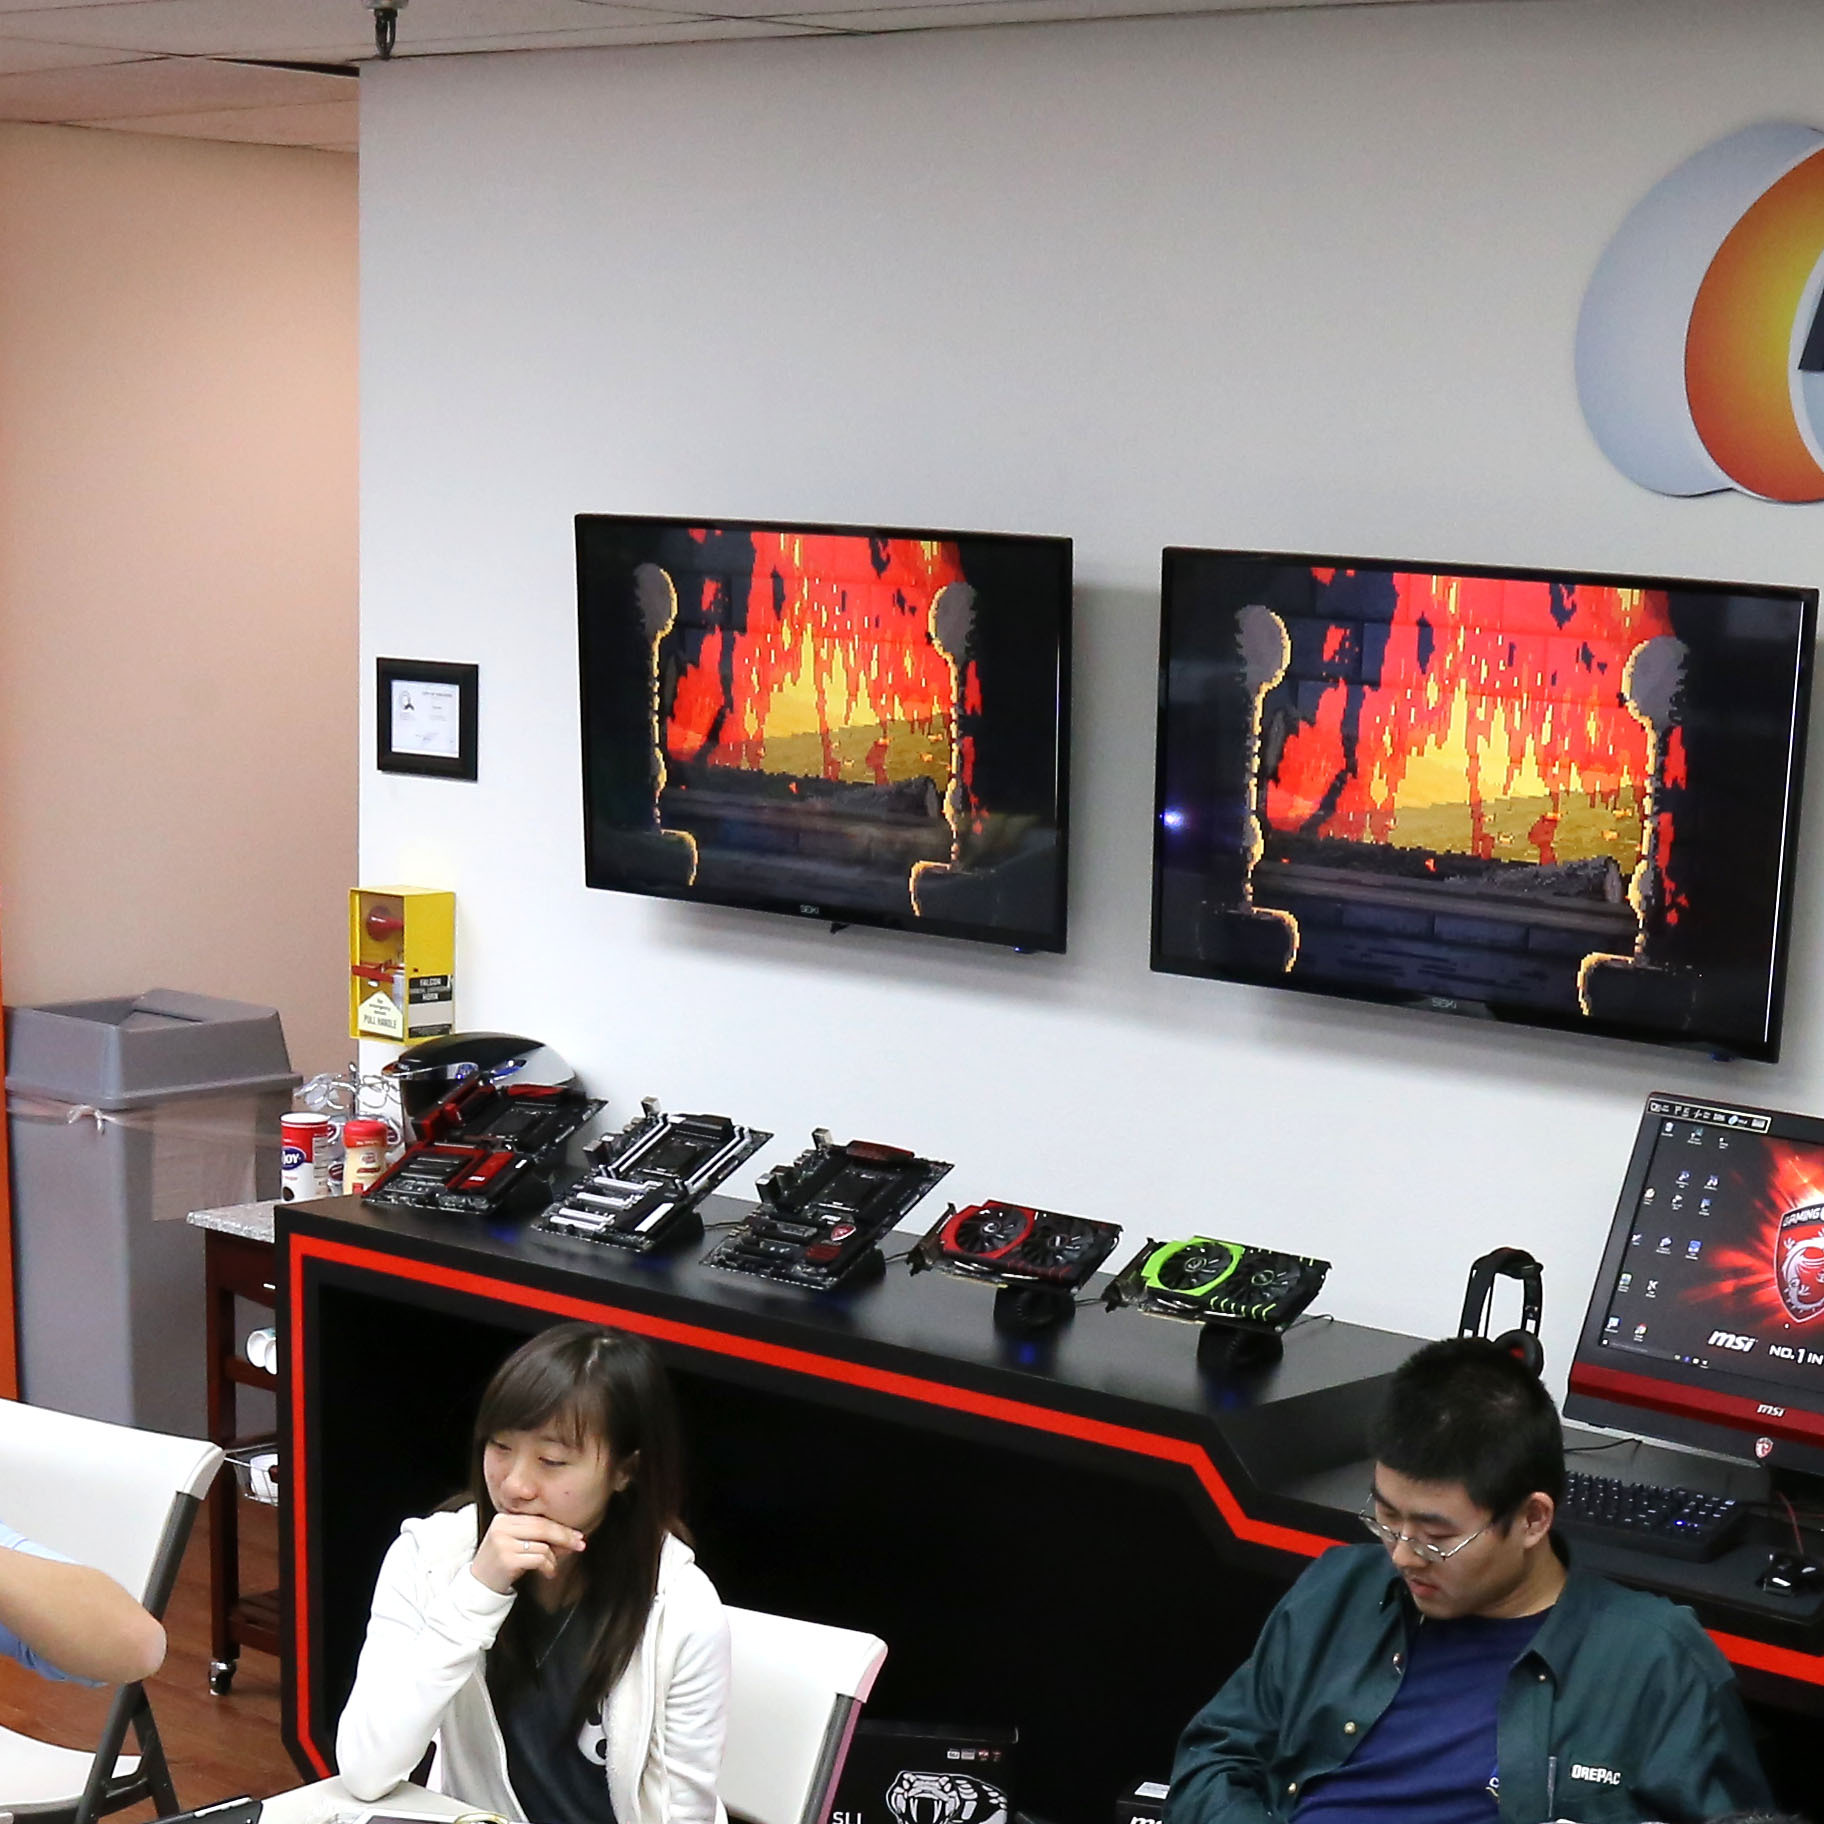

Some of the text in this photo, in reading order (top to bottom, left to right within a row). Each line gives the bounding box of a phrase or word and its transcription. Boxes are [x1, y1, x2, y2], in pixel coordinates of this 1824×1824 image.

[1707, 1330, 1757, 1353] msi
[1806, 1352, 1824, 1366] IN
[1756, 1403, 1786, 1418] msi
[1571, 1764, 1622, 1786] OREPAC
